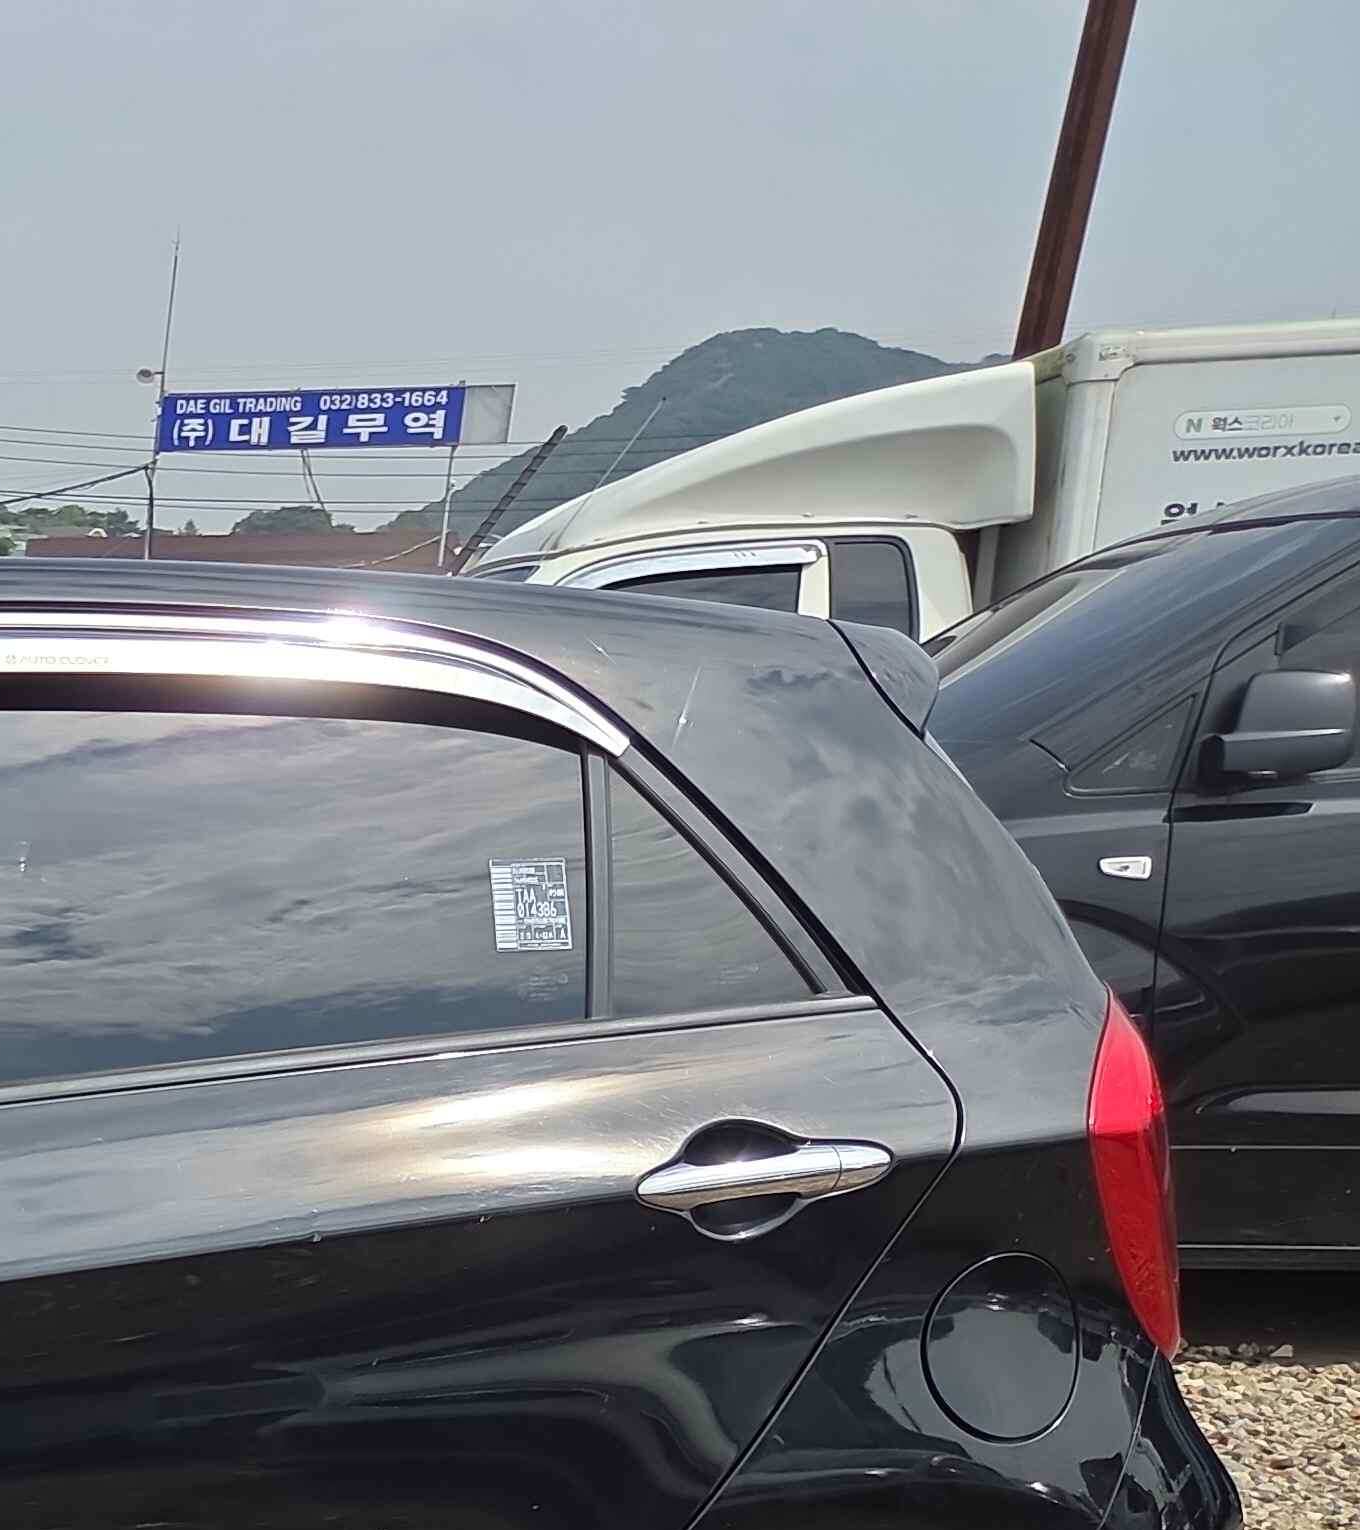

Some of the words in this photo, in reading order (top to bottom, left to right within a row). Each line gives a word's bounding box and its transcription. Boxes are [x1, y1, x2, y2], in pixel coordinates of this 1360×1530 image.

[176, 400, 205, 415] DAE
[212, 398, 235, 414] GIL
[237, 396, 302, 413] TRADING
[319, 390, 448, 411] 032)833-1664
[172, 418, 213, 448] (주)
[228, 410, 447, 446] 대길무역
